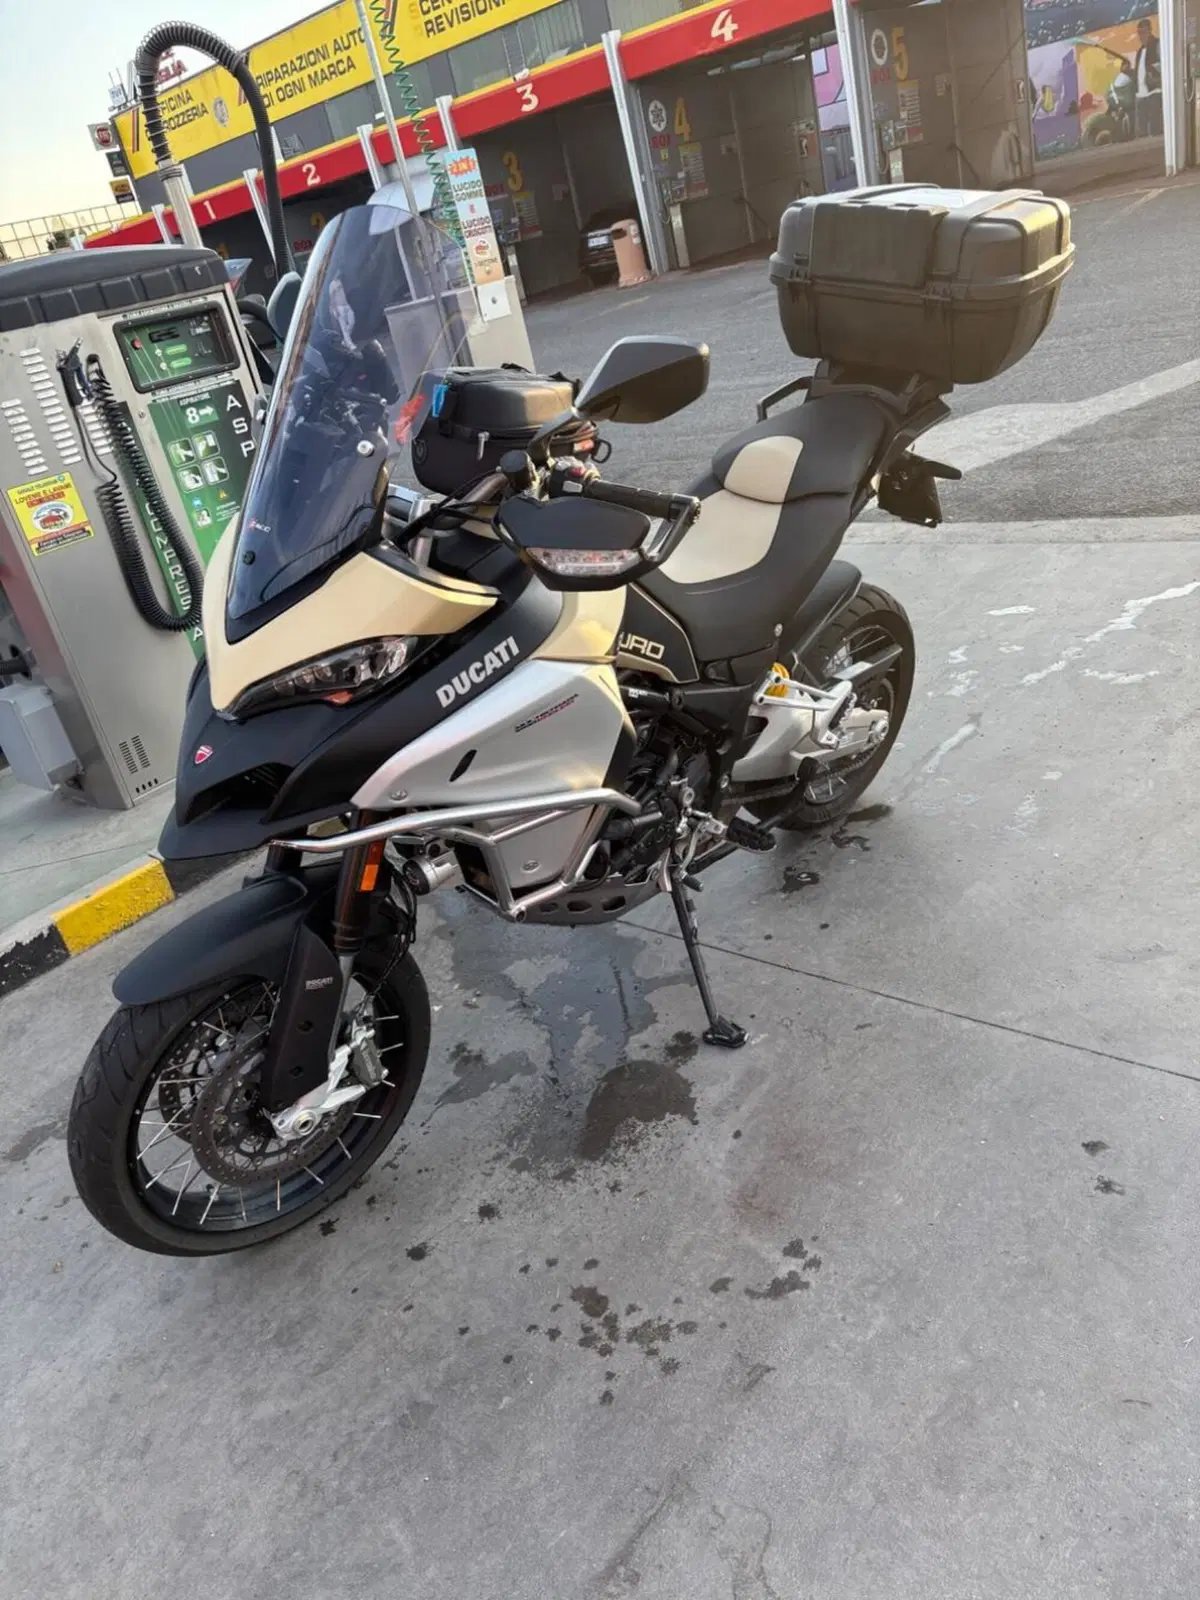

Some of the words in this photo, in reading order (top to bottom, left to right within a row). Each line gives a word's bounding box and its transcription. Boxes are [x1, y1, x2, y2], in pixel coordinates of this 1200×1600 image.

[424, 0, 505, 38] REVISION
[711, 9, 739, 42] 4
[255, 43, 330, 89] RIPARAZIONI
[892, 26, 909, 81] 5
[275, 77, 307, 103] OGNI
[308, 55, 357, 89] MARCA
[159, 88, 194, 117] FICINA
[516, 82, 539, 112] 3
[674, 97, 691, 143] 4
[302, 163, 321, 186] 2
[502, 152, 524, 192] 3
[203, 200, 217, 220] 1
[186, 407, 200, 424] 8
[618, 632, 665, 660] URO
[435, 635, 520, 708] DUCATI
